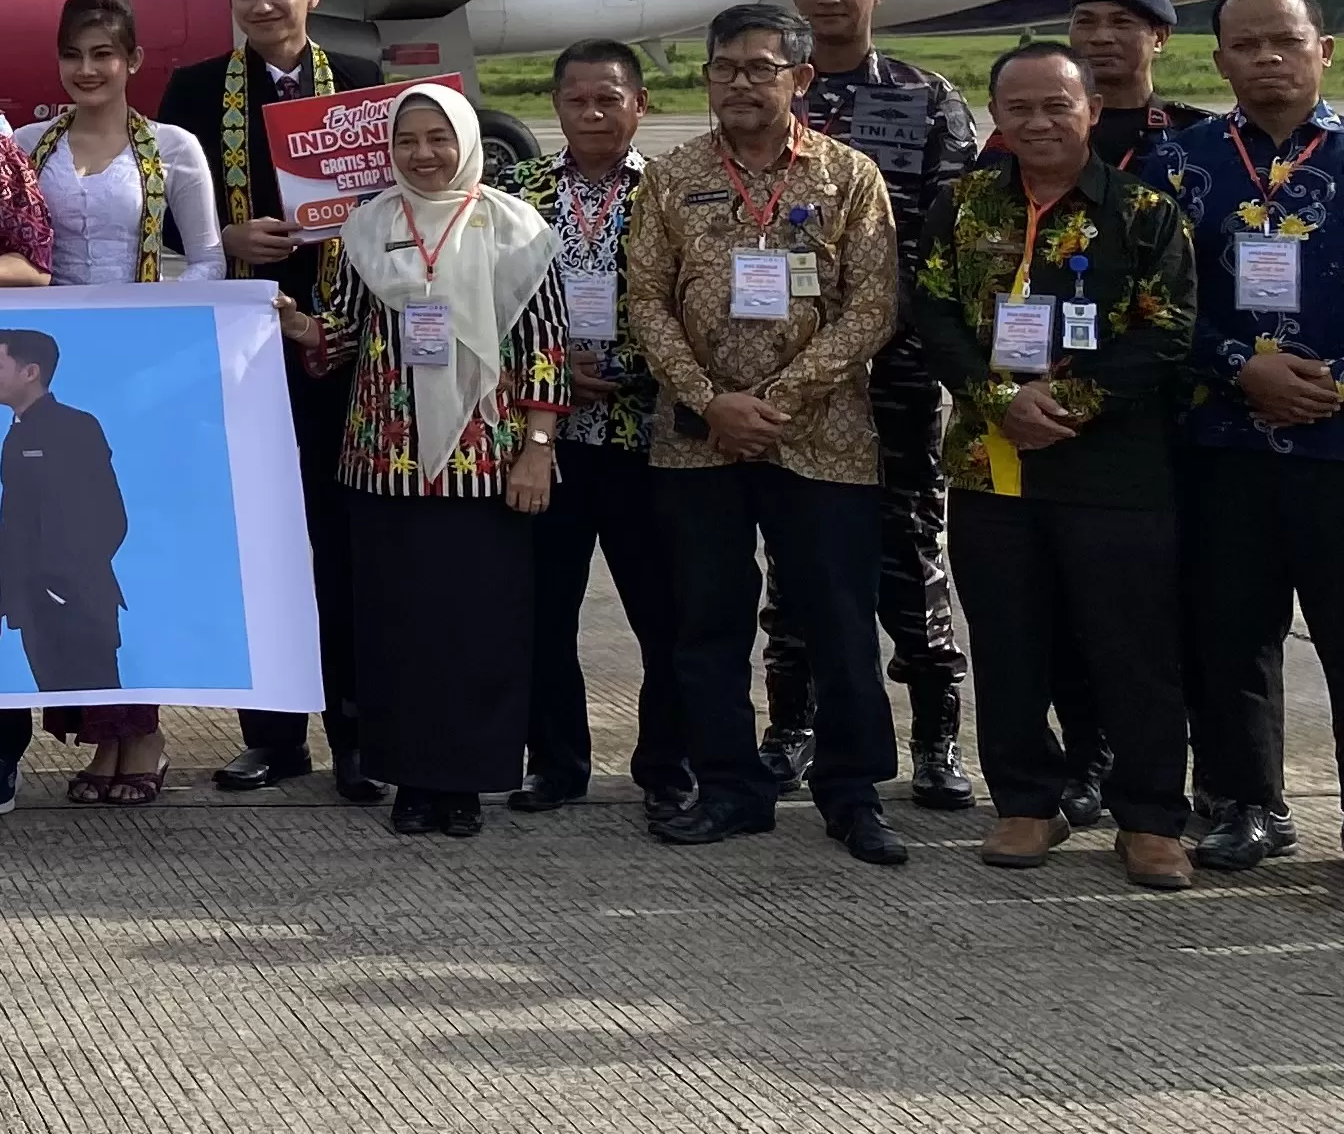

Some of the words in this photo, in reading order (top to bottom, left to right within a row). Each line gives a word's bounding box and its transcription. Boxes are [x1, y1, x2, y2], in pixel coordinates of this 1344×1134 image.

[858, 125, 886, 137] TNI
[894, 128, 920, 141] AL
[320, 153, 366, 175] GRATIS
[367, 150, 386, 168] 50
[337, 168, 380, 190] SETIAP
